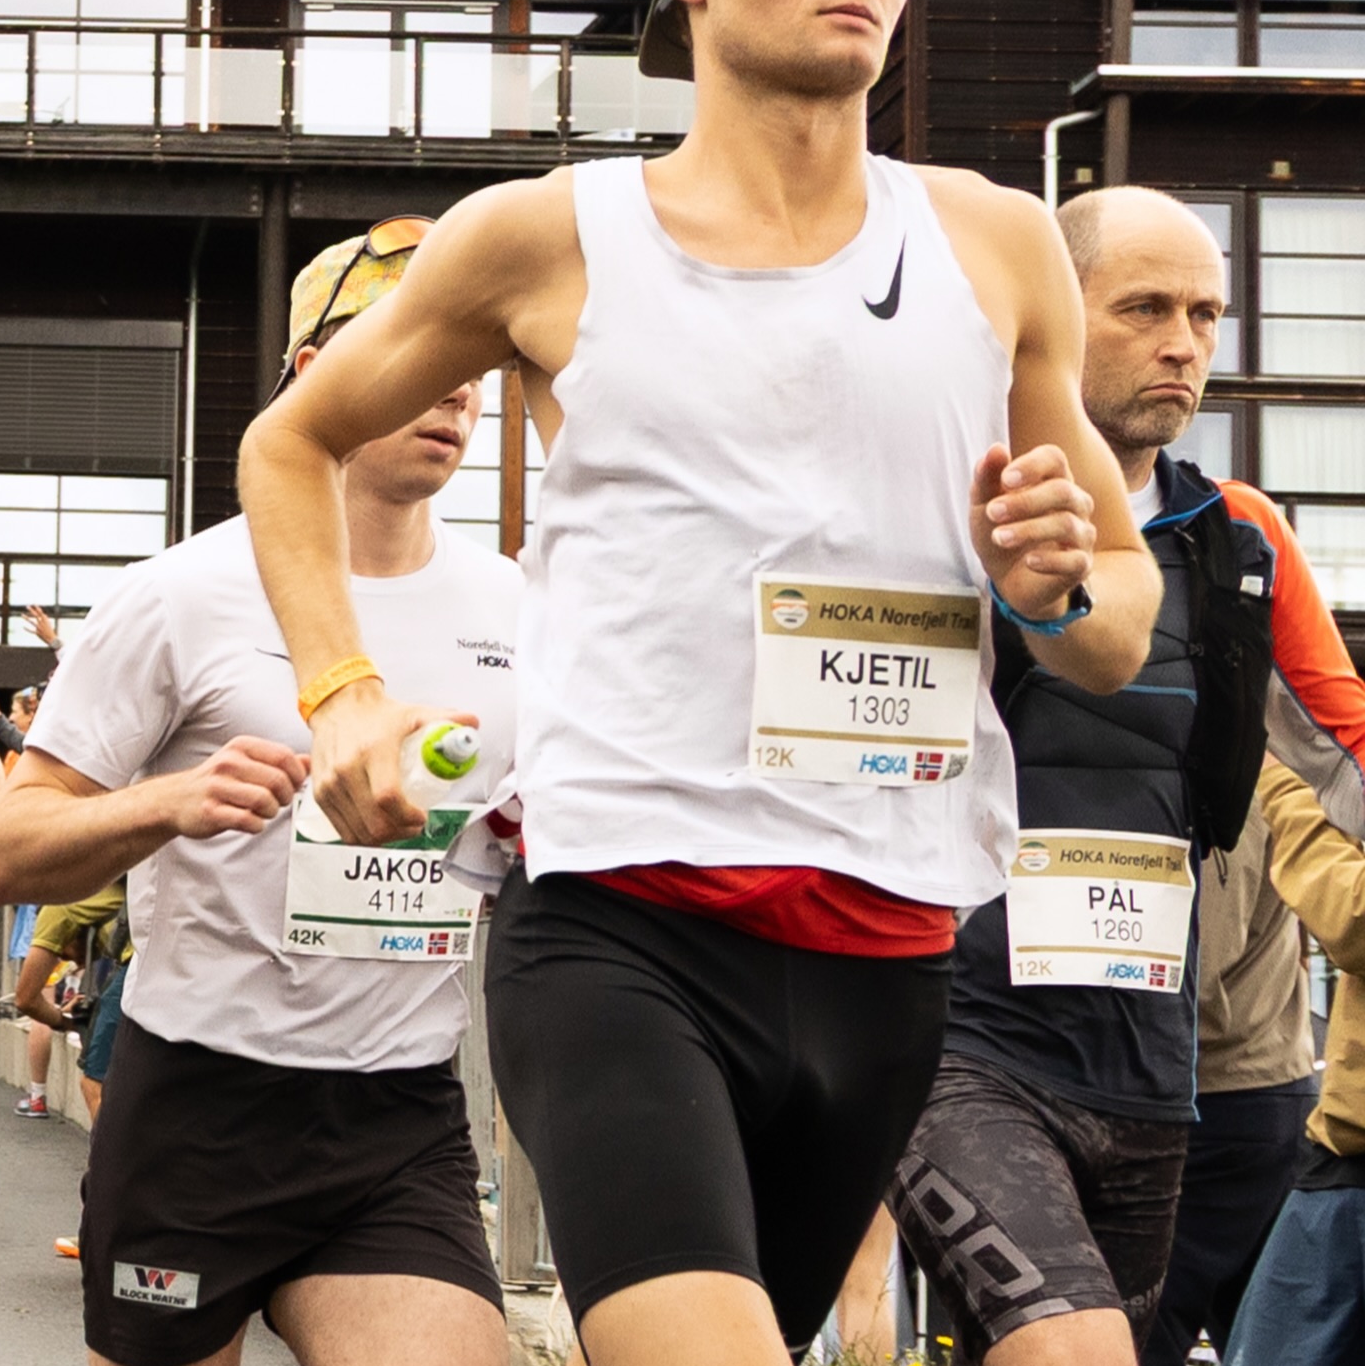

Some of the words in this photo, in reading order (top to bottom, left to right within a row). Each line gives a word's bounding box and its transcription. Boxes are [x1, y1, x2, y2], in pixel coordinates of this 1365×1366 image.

[819, 603, 874, 622] HOKA
[880, 608, 947, 631] Norefjell
[477, 655, 513, 670] HOKA
[820, 649, 937, 689] KJETIL
[848, 695, 911, 726] 1303
[755, 746, 795, 768] 12K
[859, 754, 908, 774] HOKA
[344, 855, 444, 884] JAKOB
[1059, 849, 1104, 864] HOKA
[1109, 852, 1163, 871] Norefjell
[368, 889, 424, 913] 4114
[1088, 880, 1143, 913] PÅL
[288, 929, 326, 946] 42K
[1092, 918, 1143, 942] 1260
[379, 935, 424, 952] HOKA
[1016, 960, 1053, 977] 12K
[1105, 963, 1145, 980] HOKA
[120, 1287, 149, 1301] BLOCK
